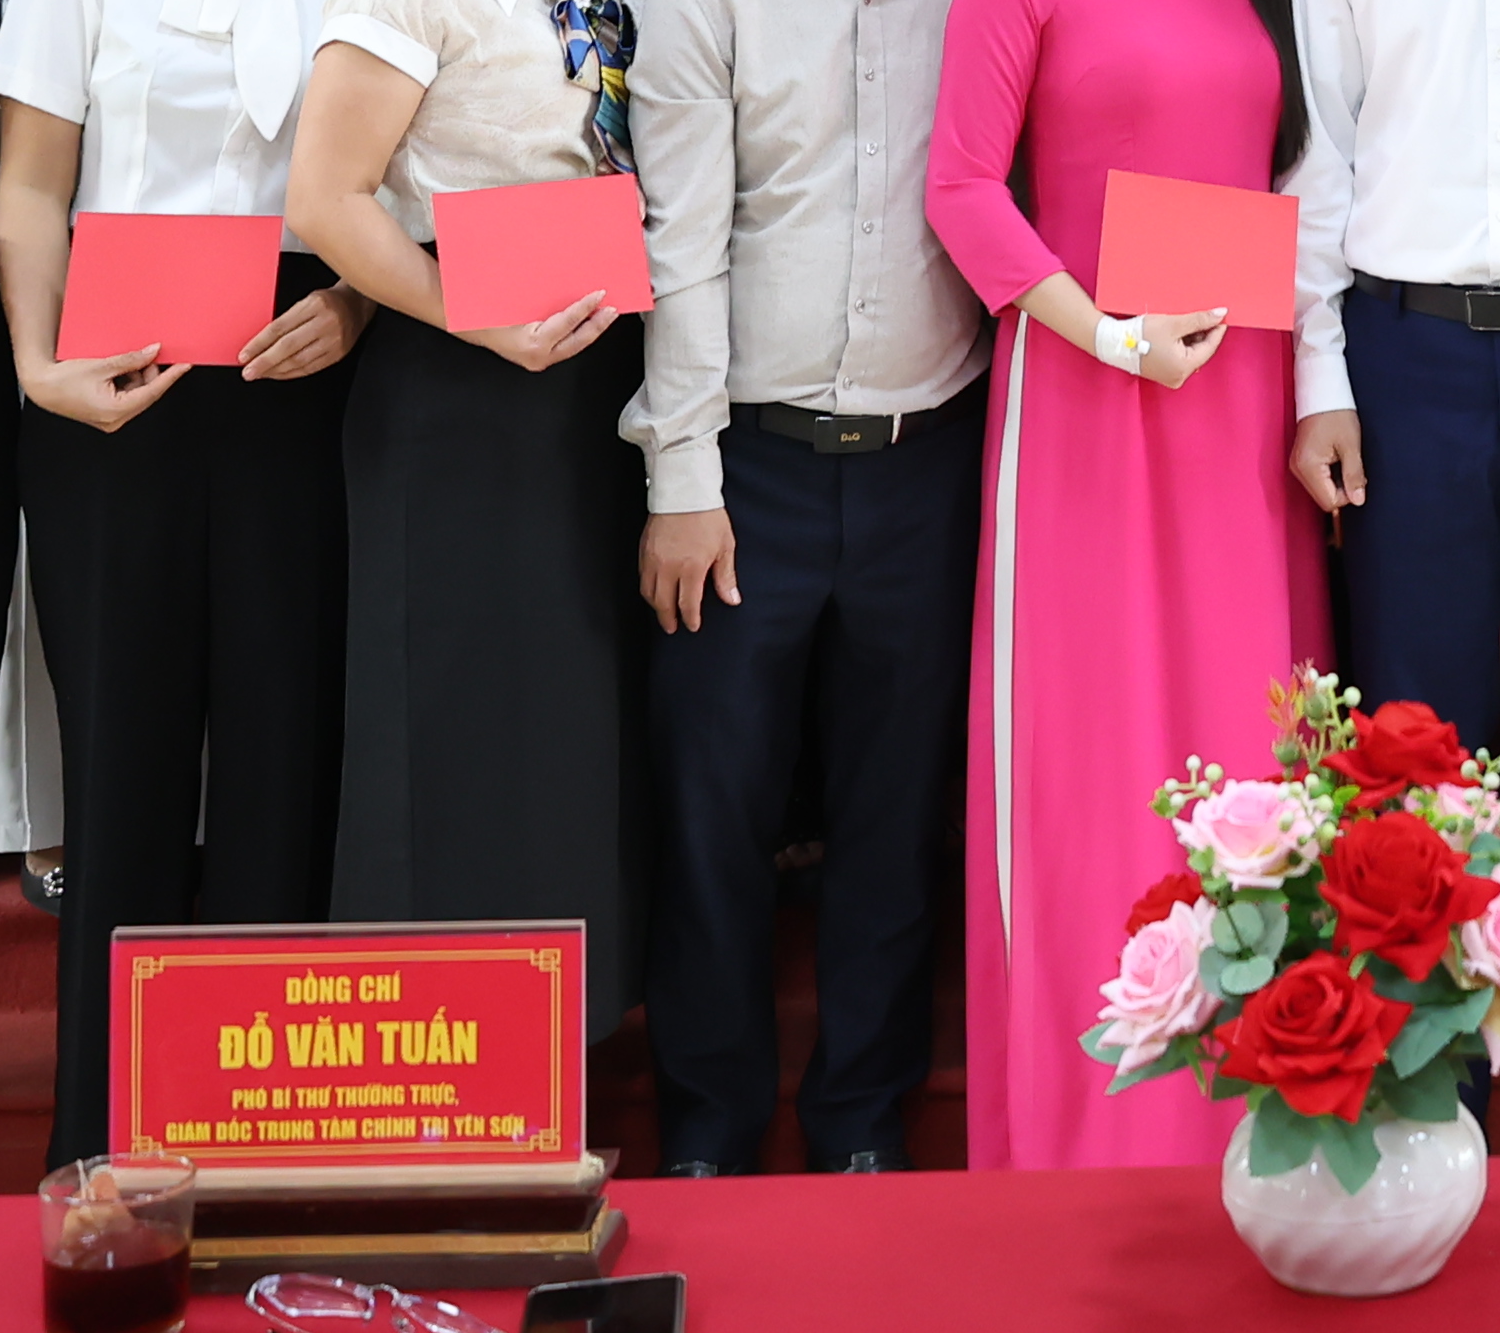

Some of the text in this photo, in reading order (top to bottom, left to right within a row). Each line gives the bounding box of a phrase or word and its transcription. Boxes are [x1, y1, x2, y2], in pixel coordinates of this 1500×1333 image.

[358, 969, 402, 1004] CHÍ
[217, 1005, 479, 1071] ĐỖ VĂN TUẤN
[231, 1085, 269, 1111] PHÓ
[272, 1084, 292, 1110] BÍ
[296, 1084, 333, 1109] THƯ
[165, 1119, 212, 1144] GIÁM
[257, 1119, 316, 1142] TRUNG
[319, 1115, 358, 1141] TÂM
[361, 1114, 417, 1140] CHÍNH
[420, 1115, 450, 1141] TRỊ
[454, 1112, 487, 1137] YÊN
[489, 1112, 526, 1137] SƠN
